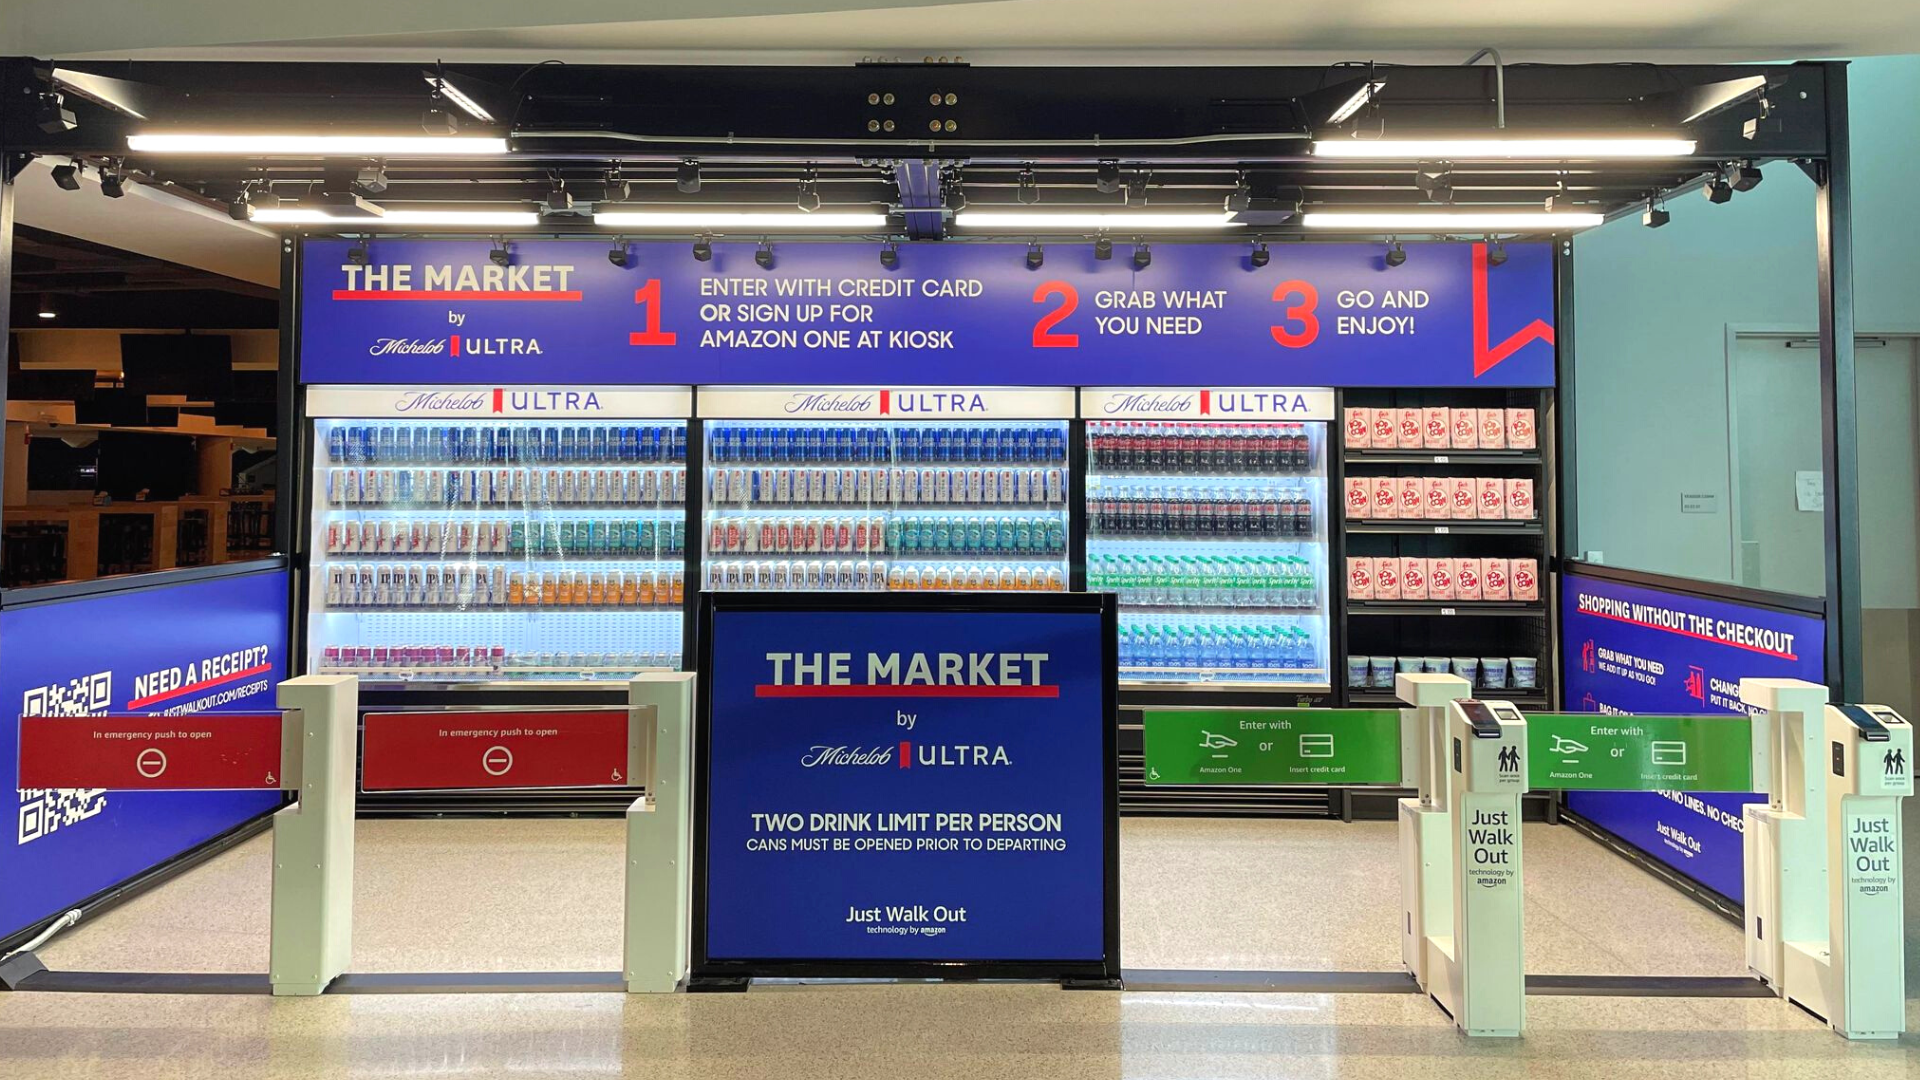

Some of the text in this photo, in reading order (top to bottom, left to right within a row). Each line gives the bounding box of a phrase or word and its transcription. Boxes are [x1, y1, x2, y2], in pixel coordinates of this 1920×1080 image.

[341, 265, 574, 291] THE MARKET
[700, 278, 983, 298] ENTER WITH CREDIT CARD
[1095, 290, 1227, 309] GRAB WHAT
[1337, 290, 1429, 309] GO AND
[448, 310, 465, 326] by
[629, 278, 676, 346] 1
[700, 304, 873, 323] OR SIGN UP FOR
[1032, 281, 1079, 348] 2
[1271, 281, 1319, 349] 3
[1095, 316, 1202, 335] YOU NEED
[1337, 316, 1415, 336] ENJOY!
[369, 338, 541, 356] Michelob ULTRA
[700, 330, 954, 349] AMAZON ONE AT KIOSK
[395, 391, 600, 412] Michelob ULTRA
[784, 394, 986, 413] Michelob ULTRA
[1104, 393, 1308, 413] Michelob ULTRA
[1579, 593, 1794, 655] SHOPPING WITHOUT THE CHECKOUT
[766, 652, 1048, 686] THE MARKET
[1598, 647, 1664, 675] GRAB WHAT YOU NEED
[135, 645, 268, 700] NEED A RECEIPT?
[1598, 662, 1656, 685] WE ADD IT UP AS YOU GO!
[1710, 678, 1740, 697] CHANG
[1710, 694, 1721, 706] PUT
[1722, 698, 1728, 708] IT
[1729, 699, 1747, 714] BACK.
[896, 710, 917, 730] by
[1239, 720, 1292, 730] Enter with
[93, 730, 102, 738] In
[104, 731, 153, 740] emergency
[155, 730, 176, 740] push
[189, 732, 212, 740] open
[439, 728, 558, 738] In emergency push to open
[1590, 726, 1644, 735] Enter with
[801, 745, 1010, 767] Michelob ULTRA
[1259, 742, 1273, 751] or
[1610, 748, 1625, 757] or
[1472, 809, 1508, 825] Just
[1672, 790, 1683, 805] NO
[1684, 794, 1706, 816] LINES.
[1707, 804, 1720, 821] NO
[1721, 811, 1744, 833] CHEC
[751, 813, 1062, 832] TWO DRINK LIMIT PER PERSON
[1853, 817, 1889, 833] Just
[746, 838, 1066, 852] CANS MUST BE OPENED PRIOR TO DEPARTING
[1468, 828, 1514, 845] Walk
[1656, 820, 1670, 837] Just
[1670, 827, 1687, 846] Walk
[1687, 837, 1702, 853] Out
[1850, 836, 1895, 853] Walk
[1474, 848, 1509, 864] Out
[1856, 856, 1890, 872] Out
[1469, 869, 1514, 877] technology by
[1477, 877, 1506, 886] amazon
[1851, 876, 1896, 884] technology by
[1859, 885, 1888, 894] amazon
[846, 906, 966, 923] Just Walk Out
[867, 925, 946, 936] technology by amazon
